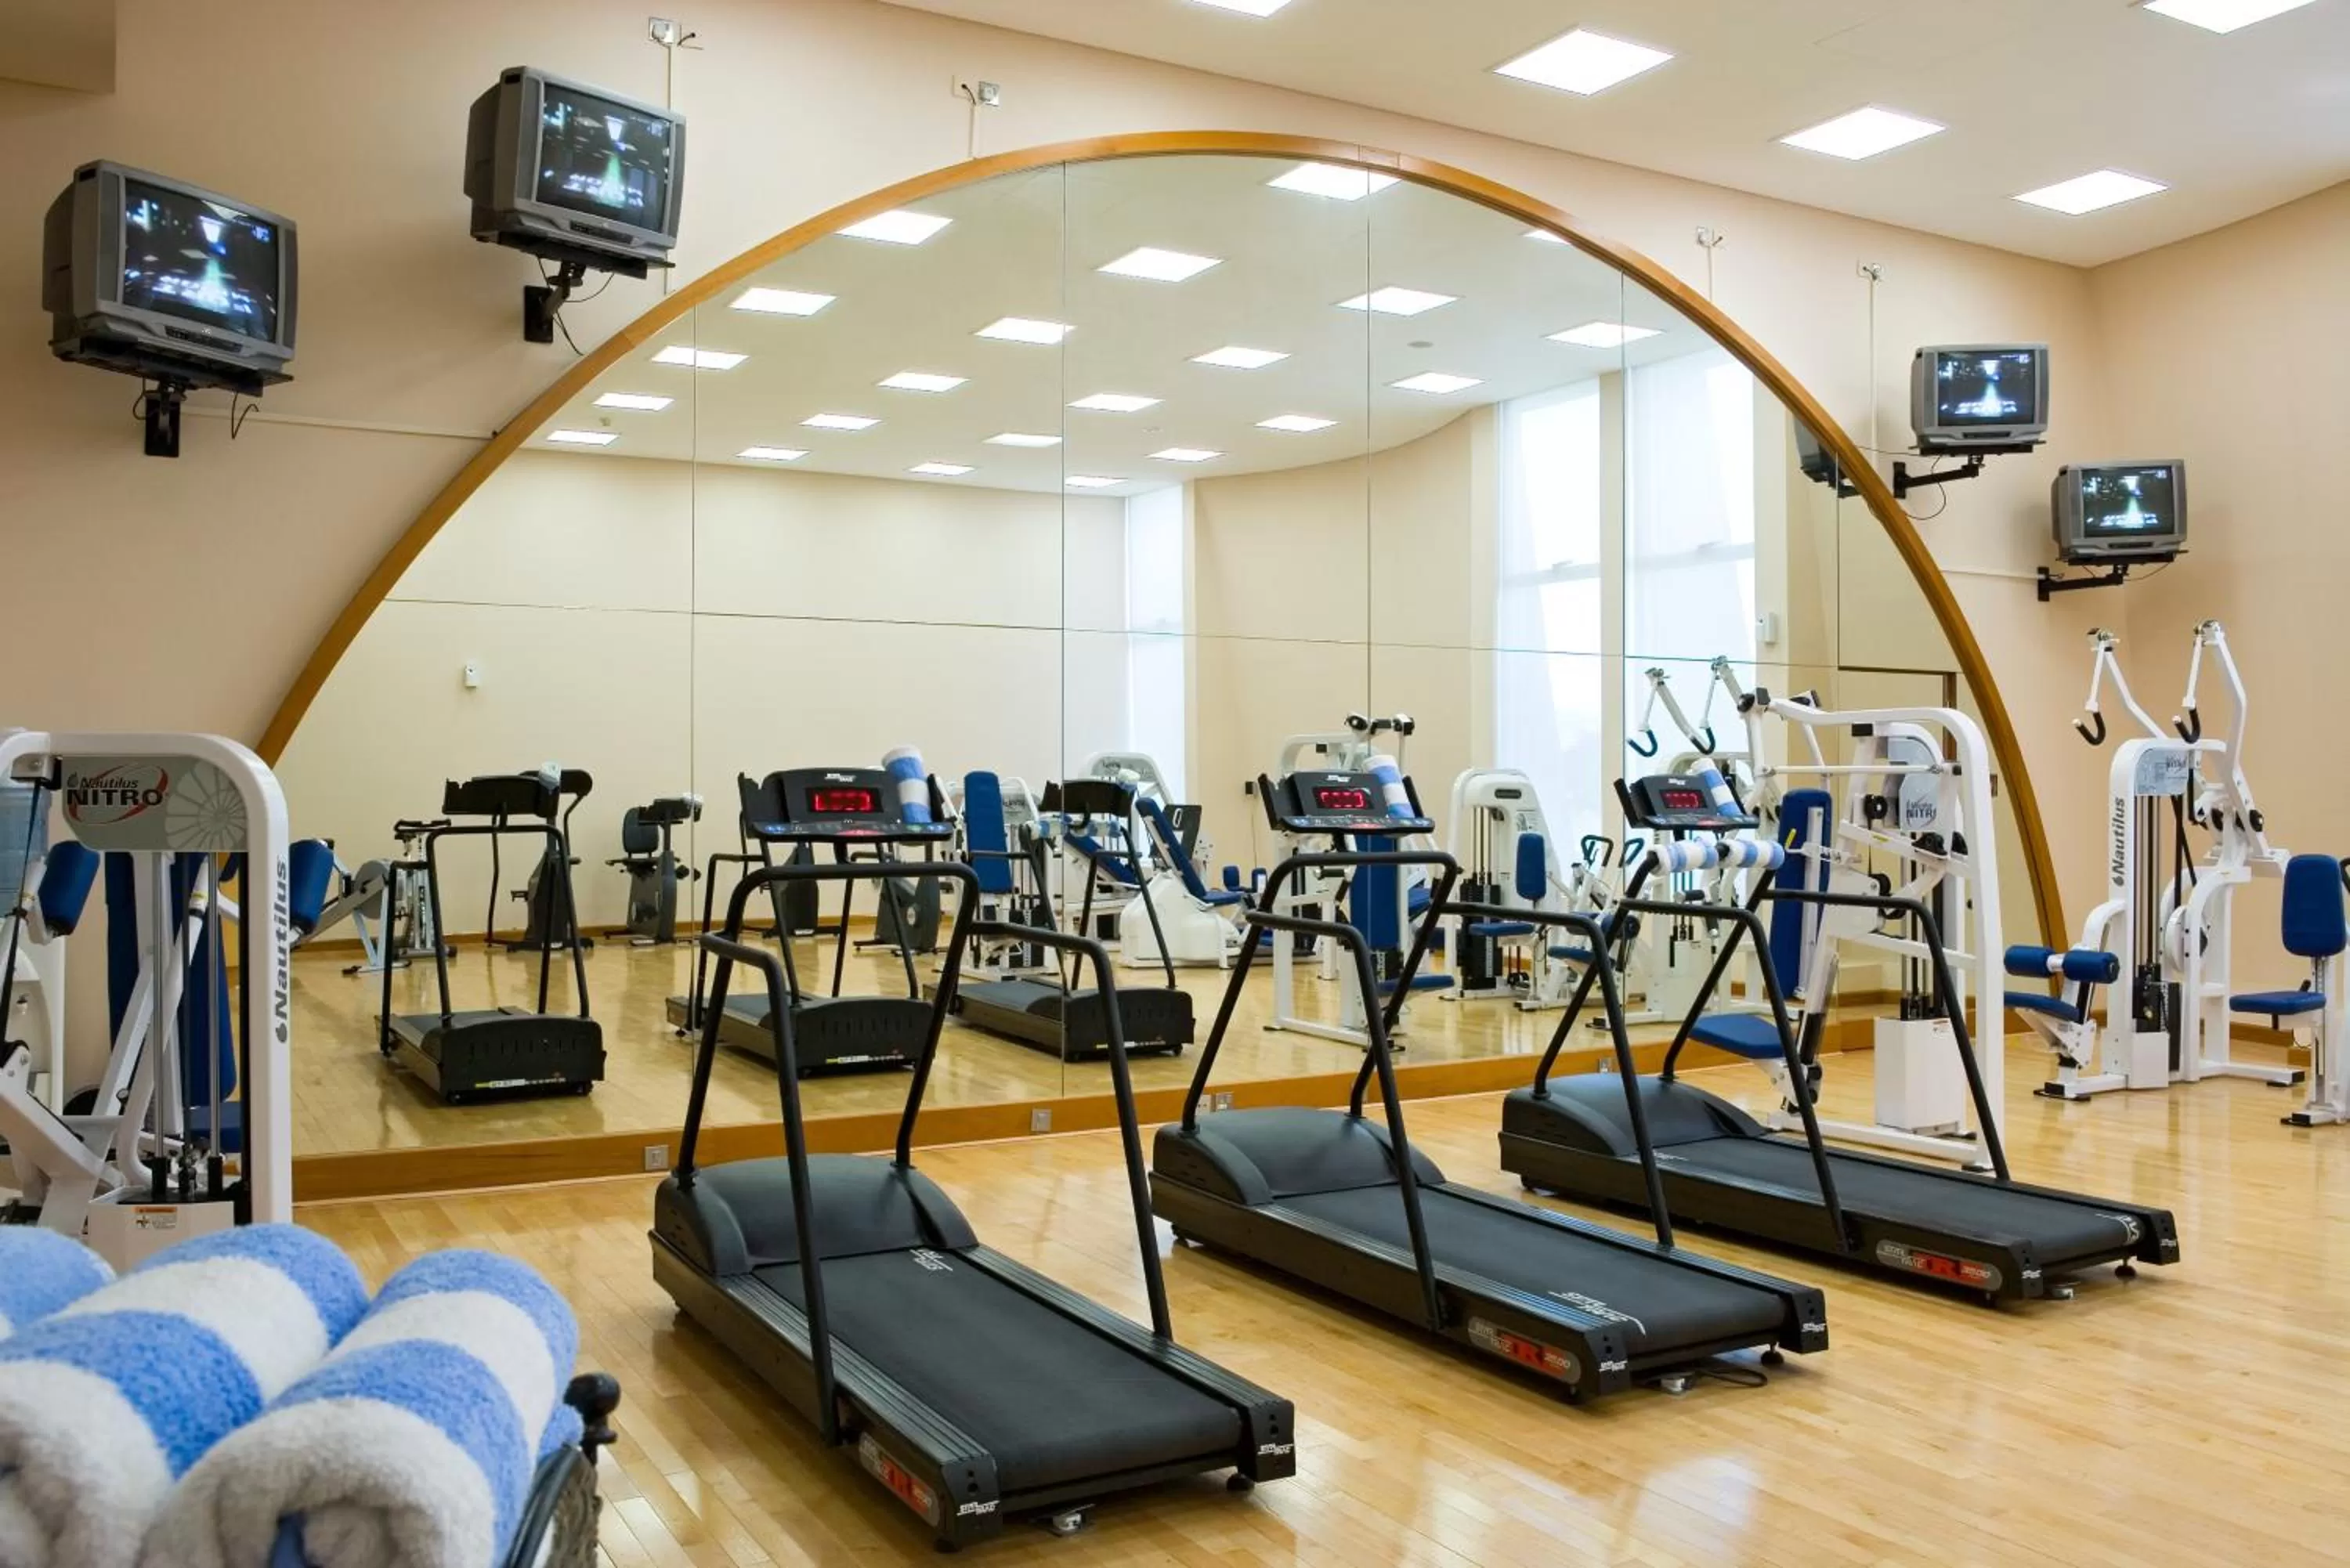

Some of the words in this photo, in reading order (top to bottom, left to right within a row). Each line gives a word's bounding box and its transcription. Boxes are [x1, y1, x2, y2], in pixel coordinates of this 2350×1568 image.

[80, 776, 139, 789] Nautilus
[67, 789, 163, 806] NITRO
[1906, 807, 1937, 818] NITR
[2112, 797, 2125, 875] Nautilus
[274, 858, 287, 1019] Nautilus
